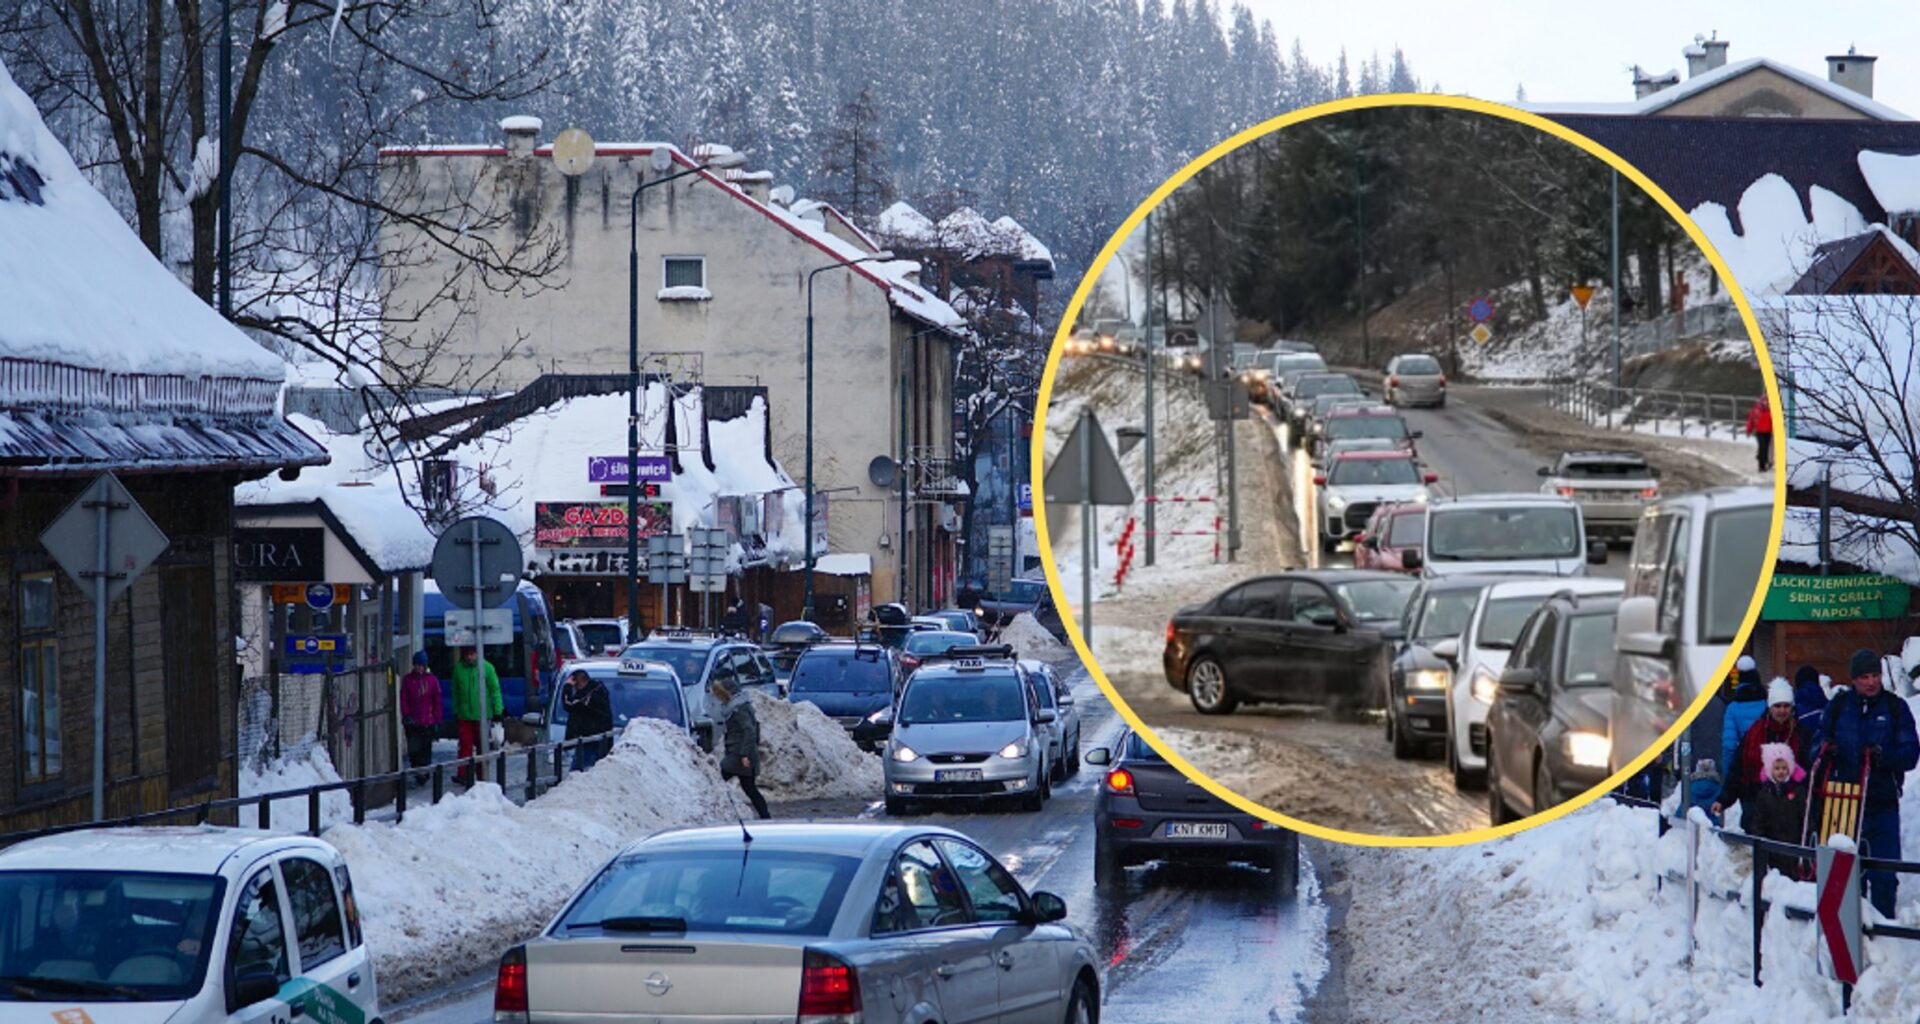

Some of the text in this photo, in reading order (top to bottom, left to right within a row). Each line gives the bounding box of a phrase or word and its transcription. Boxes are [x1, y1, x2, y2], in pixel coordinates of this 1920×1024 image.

[1789, 591, 1825, 603] SERKI
[1828, 594, 1836, 604] Z
[623, 663, 645, 671] TAXI
[1173, 823, 1226, 835] KNT KM19
